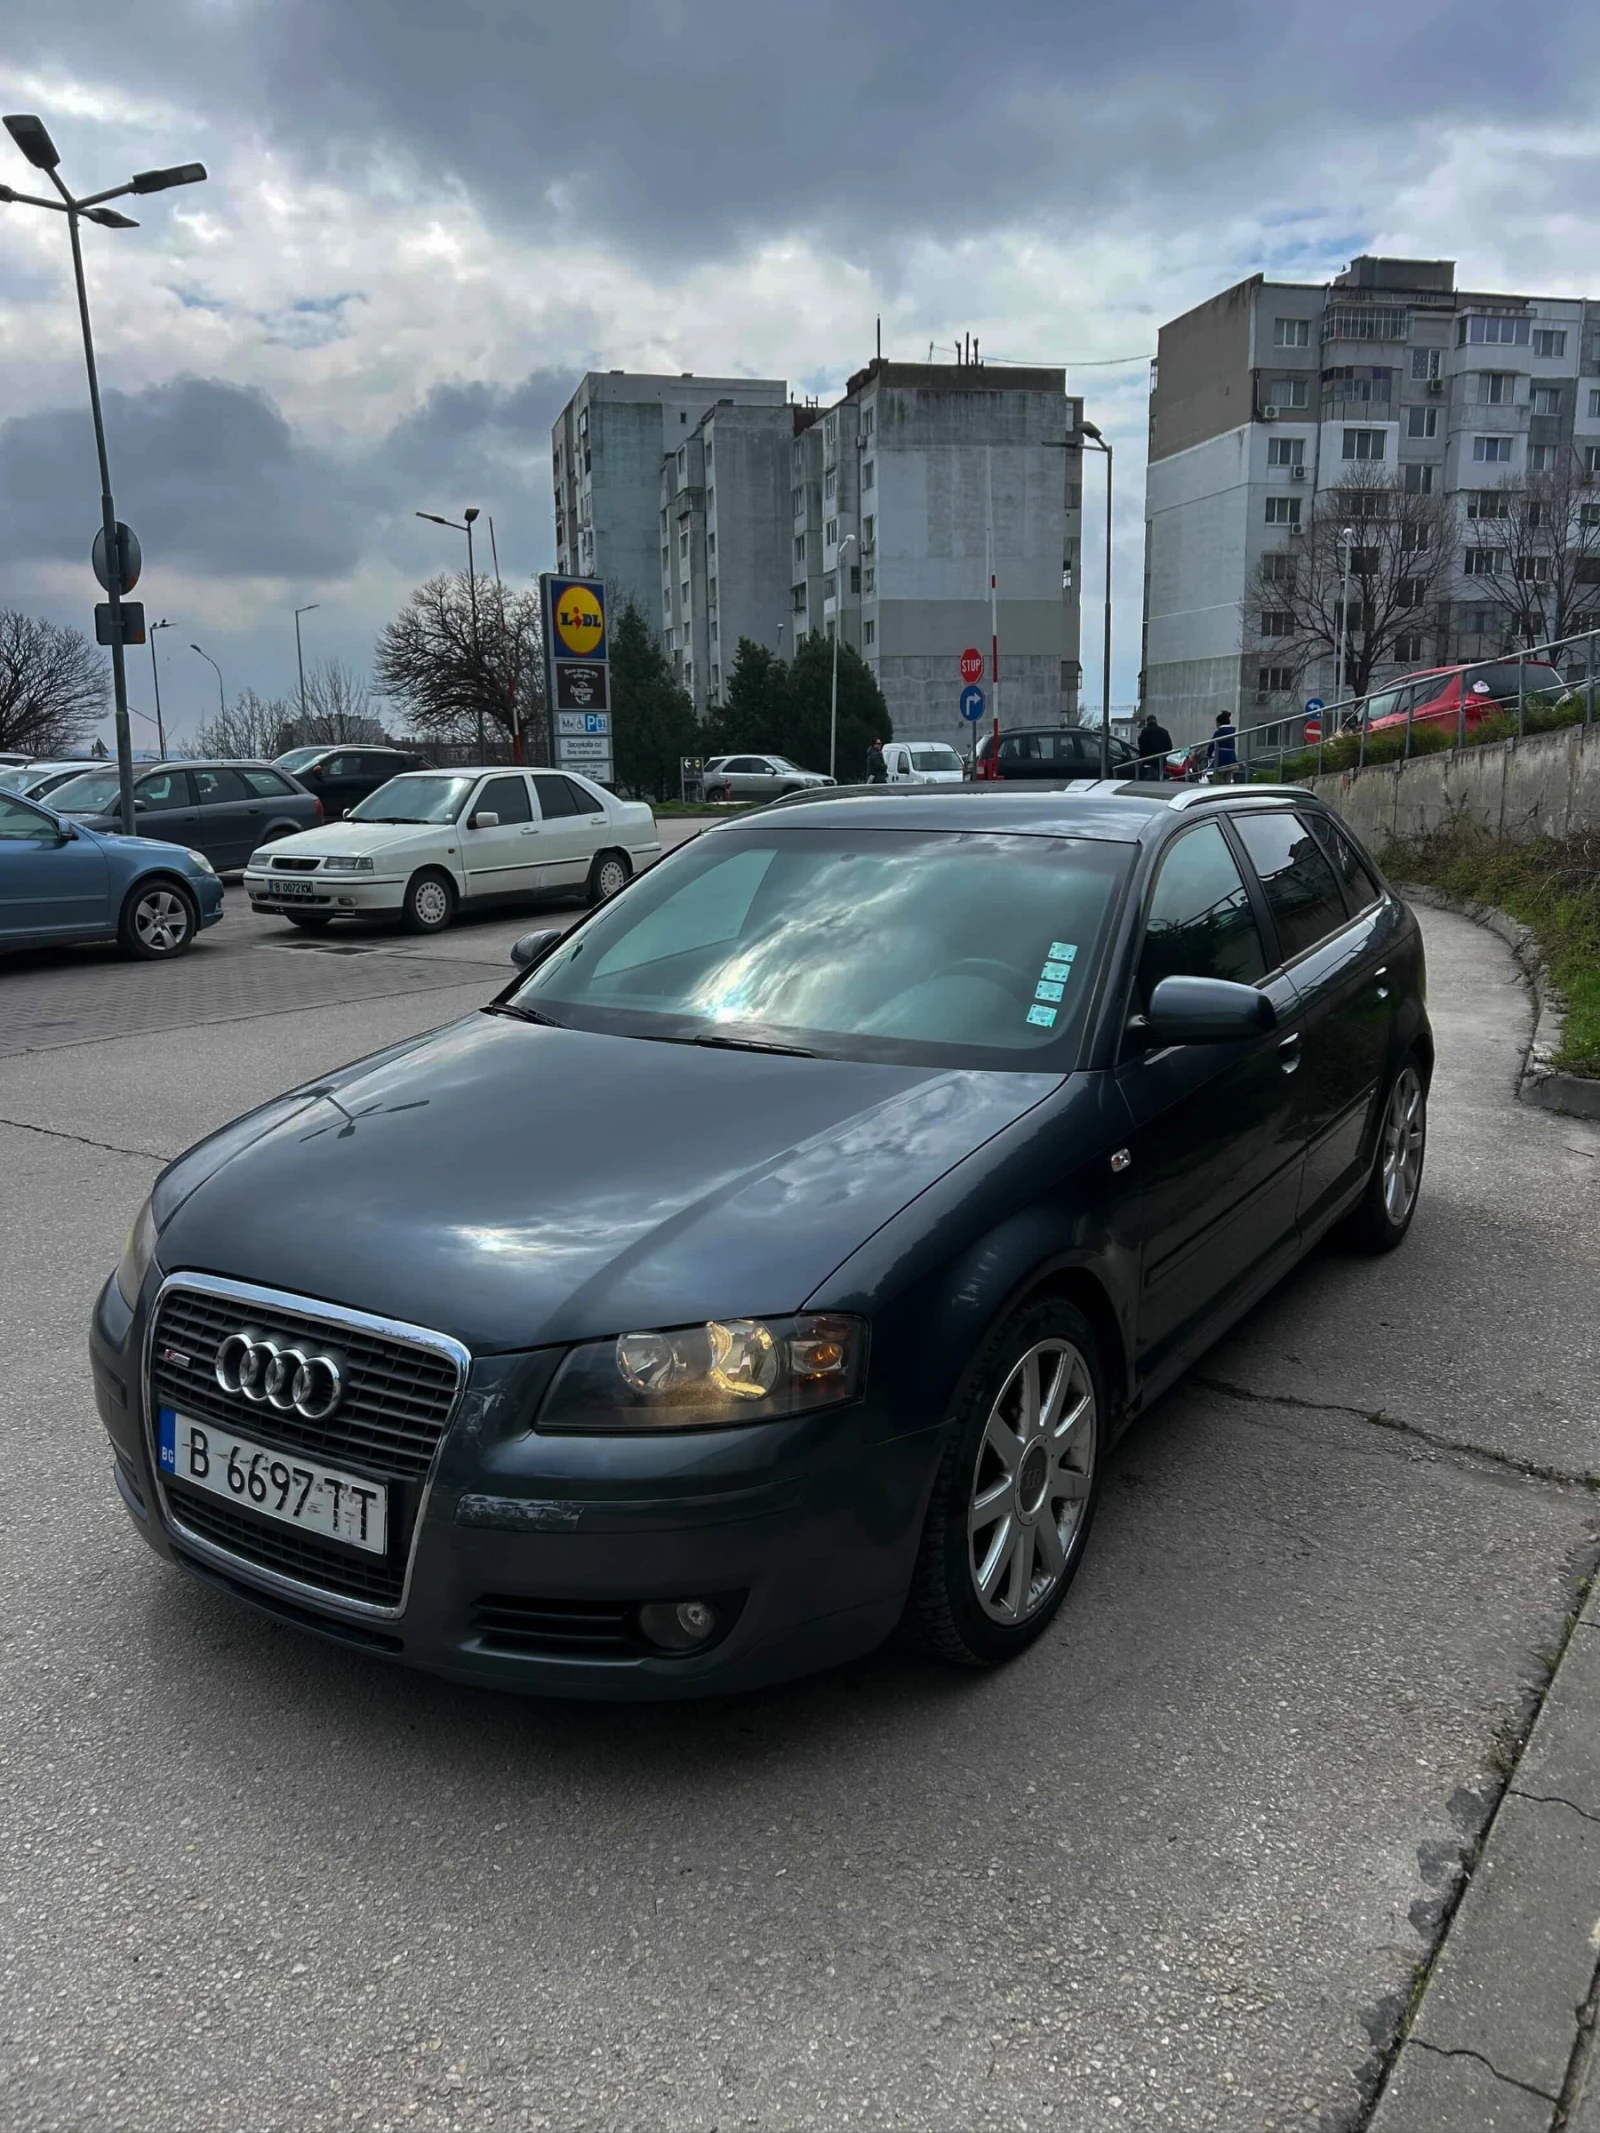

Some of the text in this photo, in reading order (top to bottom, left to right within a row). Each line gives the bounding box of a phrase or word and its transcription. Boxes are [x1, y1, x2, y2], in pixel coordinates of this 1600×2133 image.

[961, 659, 981, 672] STOP
[587, 715, 607, 731] P 81
[162, 1446, 174, 1464] BG
[190, 1427, 209, 1479] B
[227, 1445, 314, 1517] 6697
